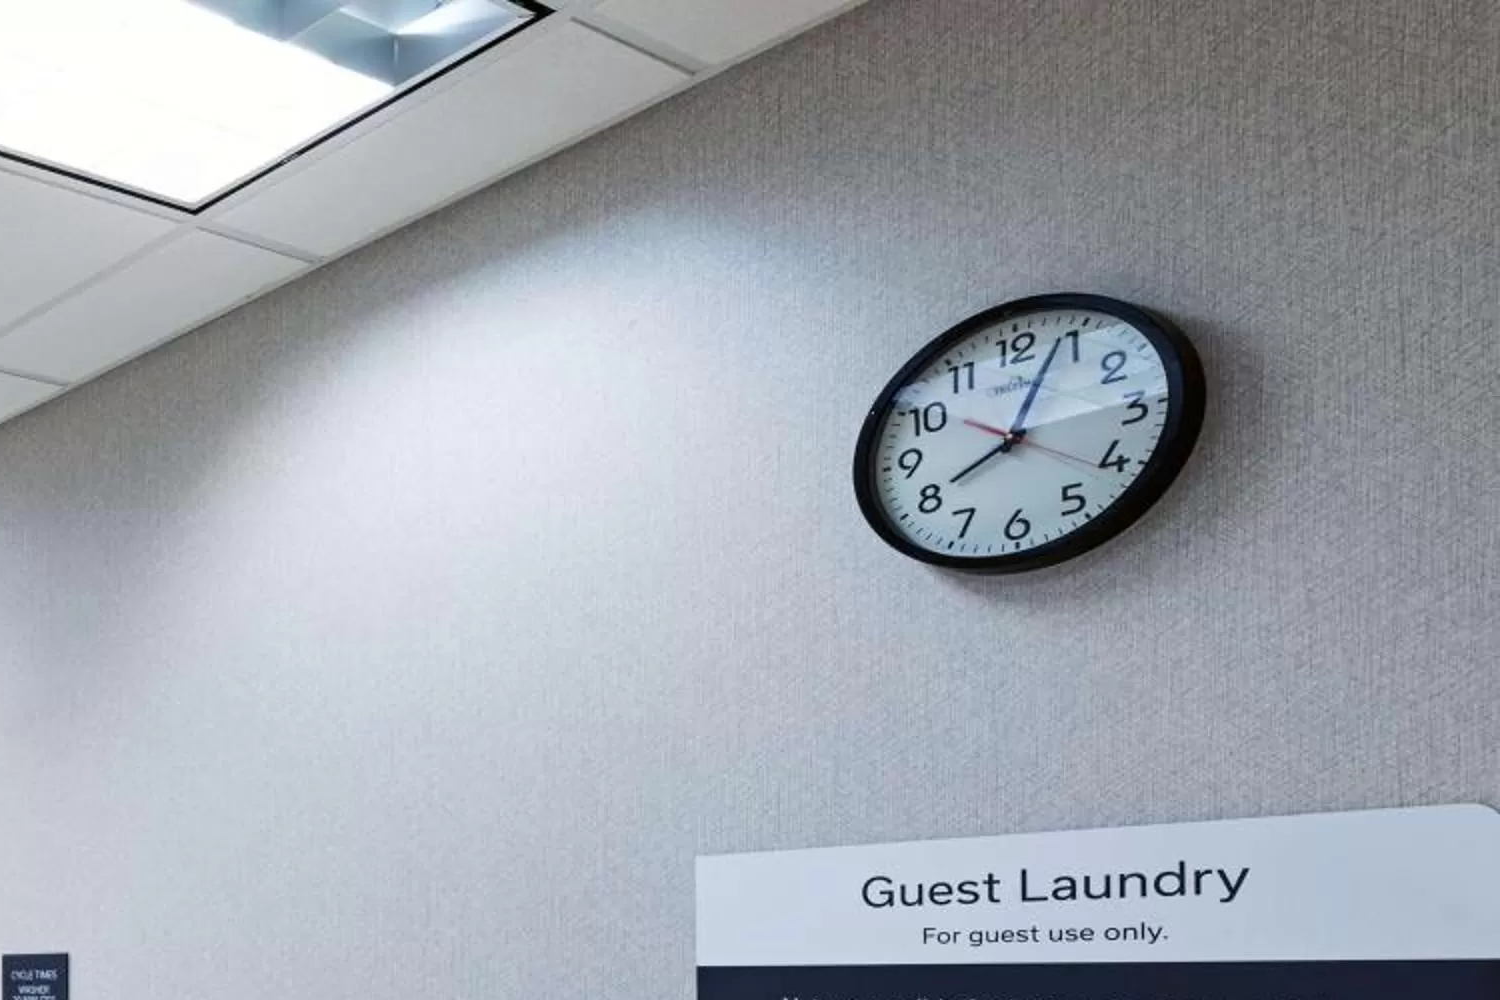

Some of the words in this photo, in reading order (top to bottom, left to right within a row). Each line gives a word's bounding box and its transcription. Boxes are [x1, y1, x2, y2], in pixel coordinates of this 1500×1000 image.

[996, 331, 1036, 367] 12
[1065, 330, 1080, 363] 1
[948, 362, 976, 394] 11
[1101, 352, 1127, 385] 2
[909, 401, 947, 436] 10
[1121, 390, 1149, 426] 3
[898, 448, 923, 479] 9
[1099, 439, 1131, 473] 4
[918, 483, 943, 514] 8
[1060, 482, 1087, 516] 5
[951, 507, 977, 538] 7
[1004, 508, 1031, 541] 6
[861, 872, 1001, 909] Guest
[1020, 859, 1250, 904] Laundry
[923, 927, 961, 945] For
[969, 926, 1039, 947] guest
[1048, 927, 1095, 943] use
[1103, 921, 1168, 945] only.
